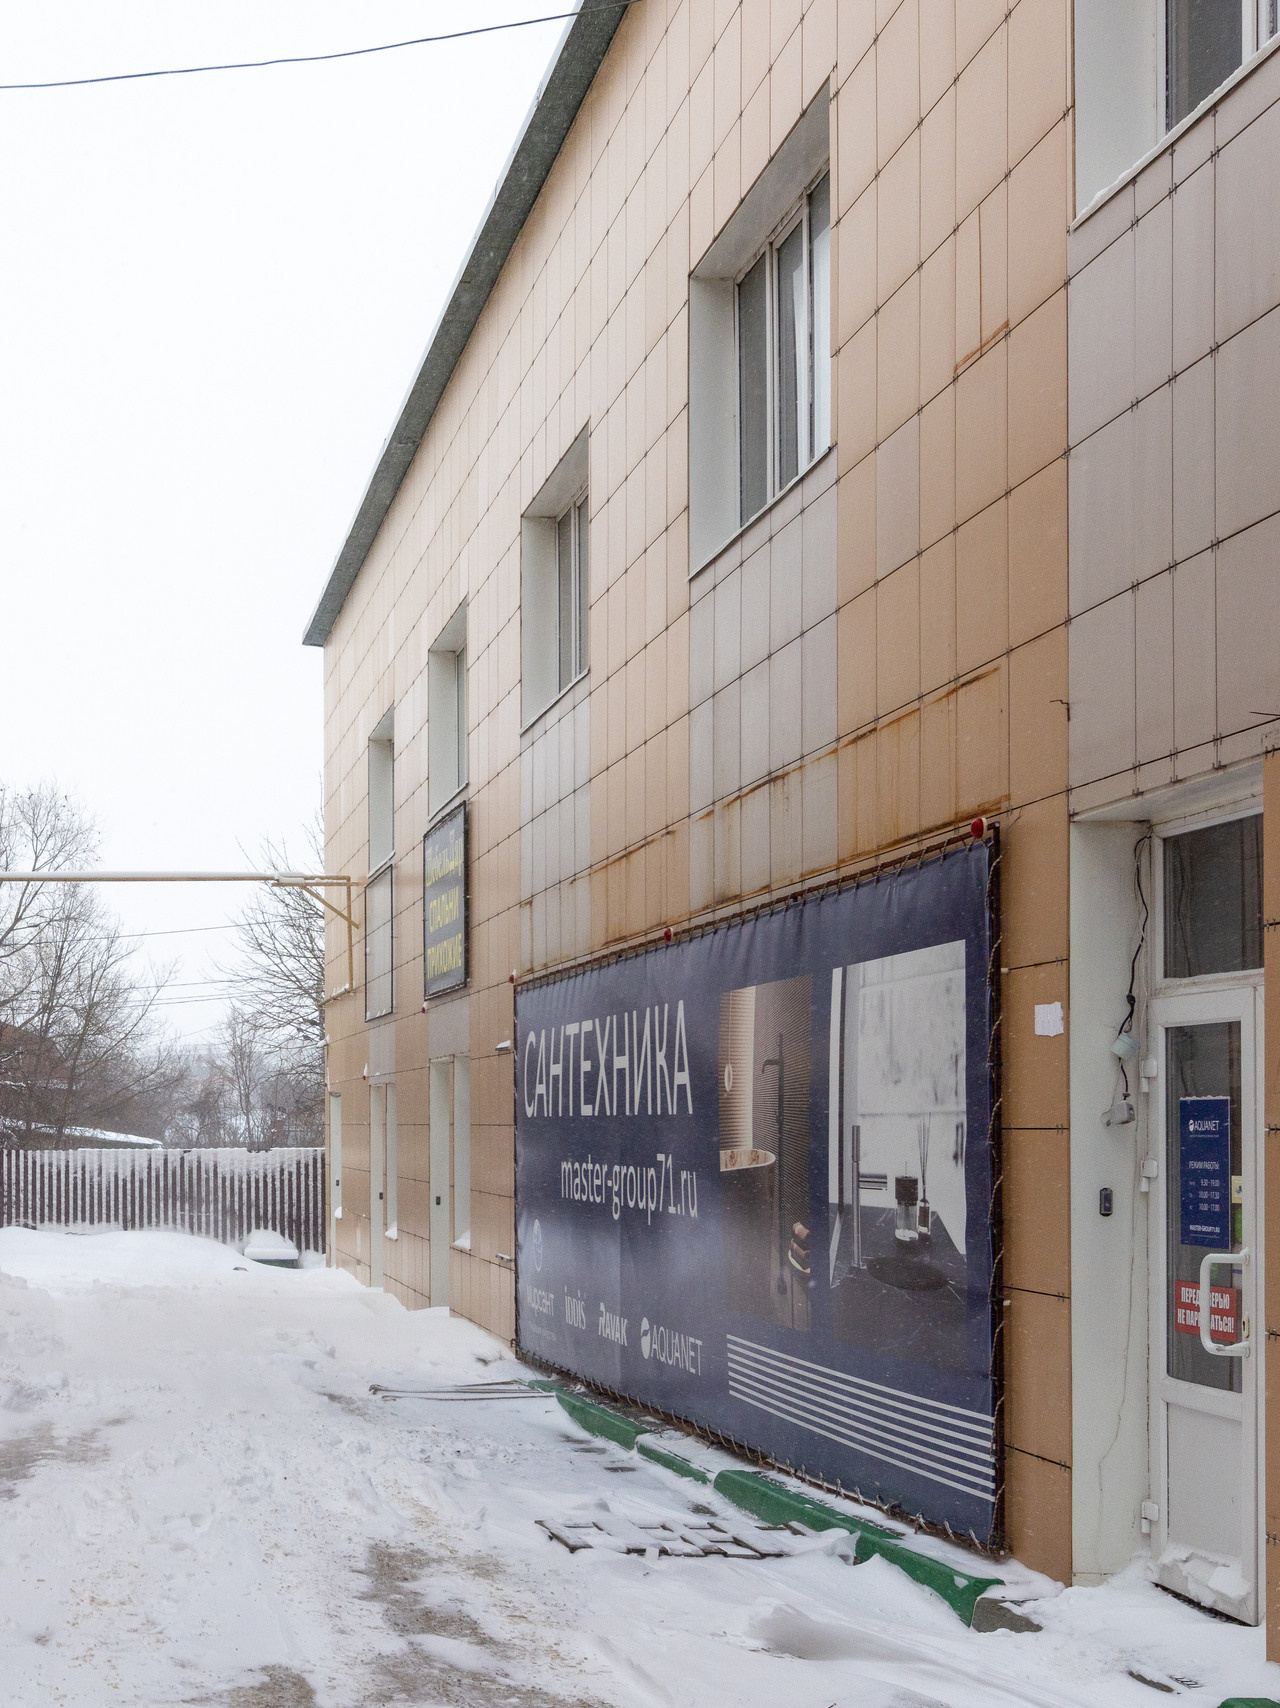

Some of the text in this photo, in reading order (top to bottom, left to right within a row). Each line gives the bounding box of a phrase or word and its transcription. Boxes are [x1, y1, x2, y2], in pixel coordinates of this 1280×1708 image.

[429, 885, 459, 933] СПАЛЬНИ
[524, 999, 693, 1118] САНТЕХНИКА
[1194, 1120, 1220, 1132] AQUANET
[560, 1153, 698, 1226] master-group71.ru
[598, 1302, 628, 1346] RAVAK
[1177, 1308, 1186, 1325] НЕ
[650, 1324, 703, 1376] AQUANET
